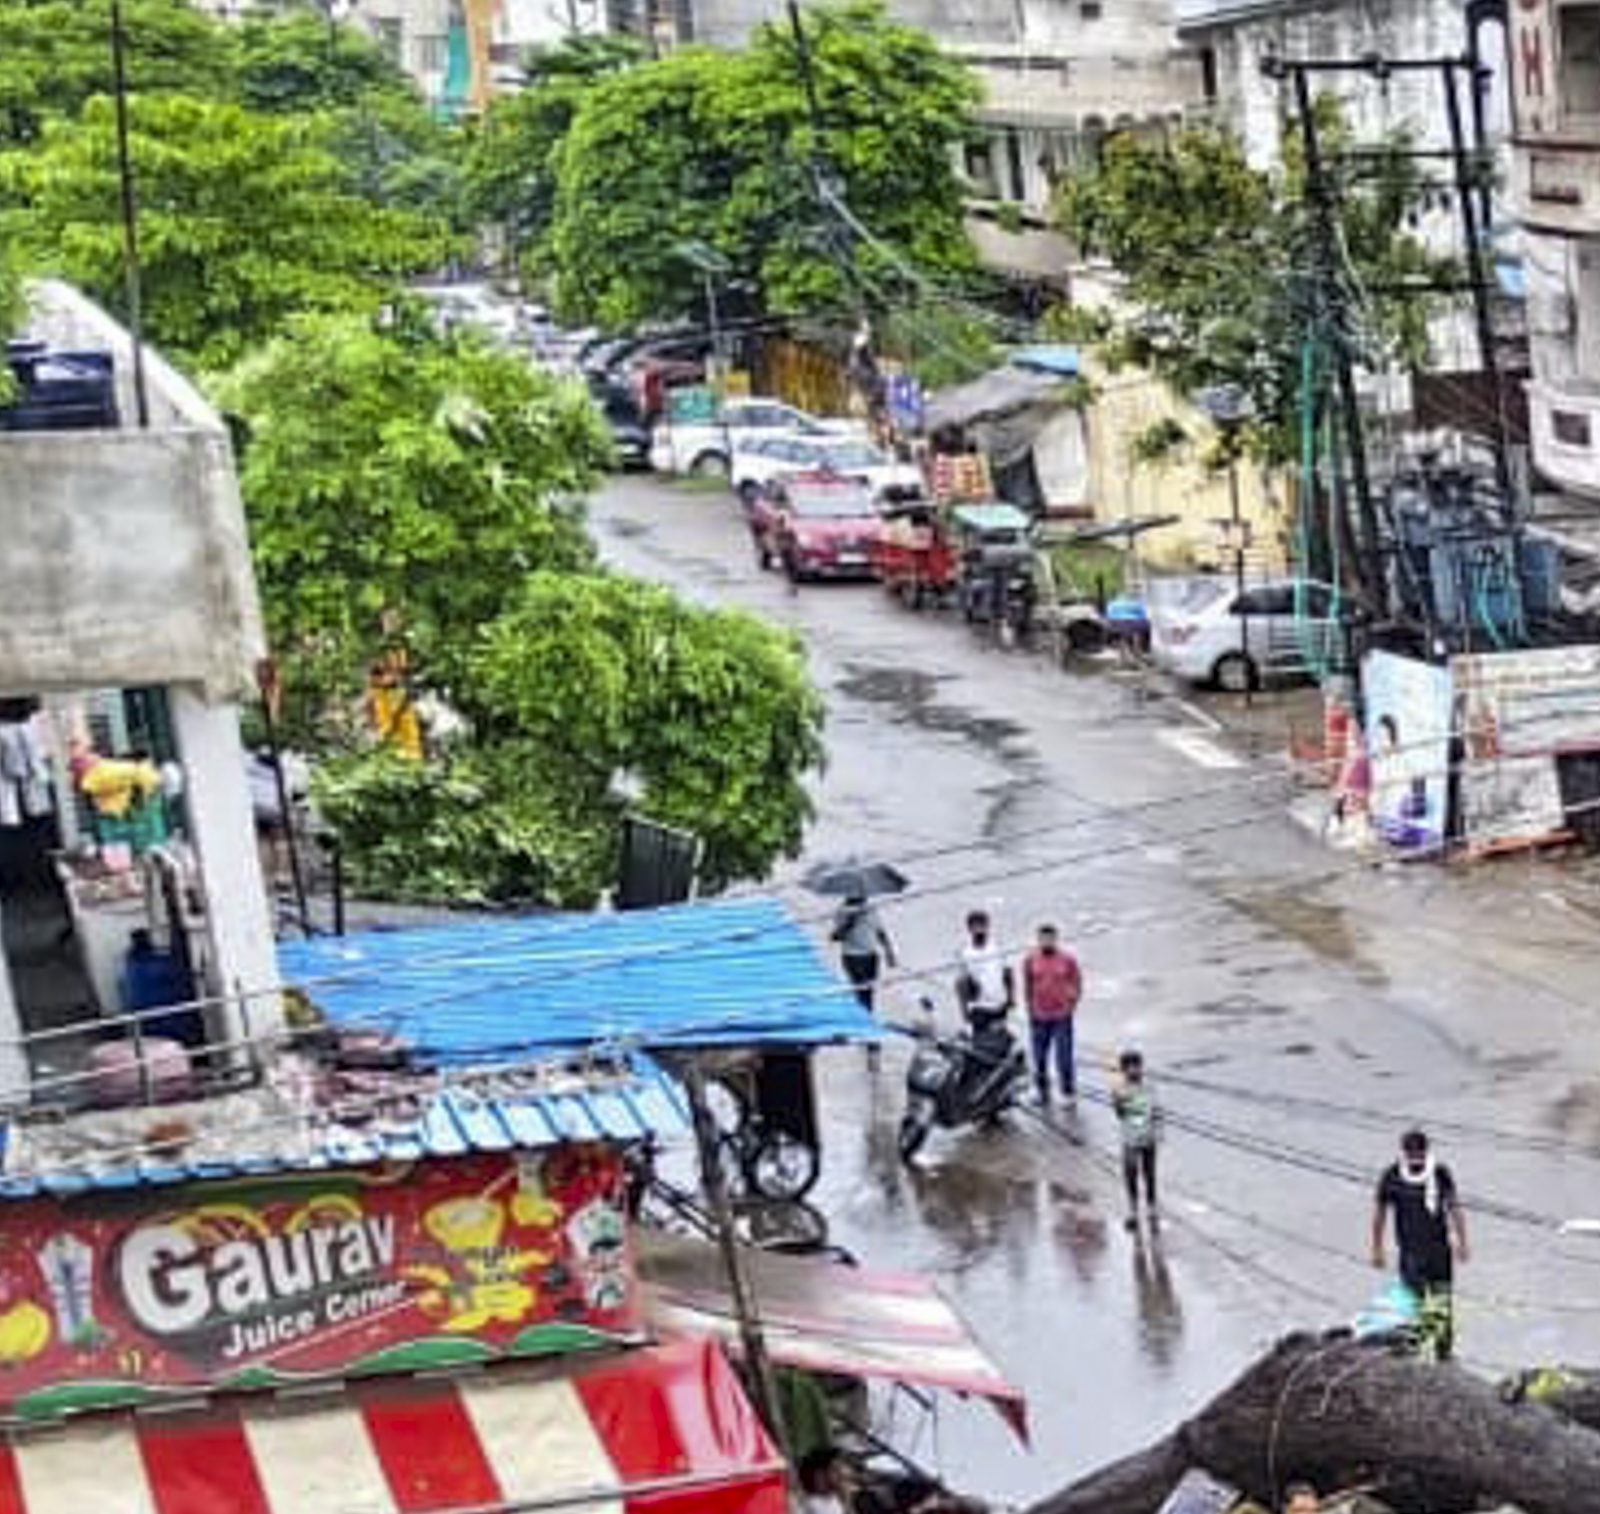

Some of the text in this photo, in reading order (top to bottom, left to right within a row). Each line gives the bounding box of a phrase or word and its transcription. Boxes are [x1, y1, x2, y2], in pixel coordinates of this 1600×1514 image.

[120, 1213, 395, 1333] Gaurav
[221, 1279, 407, 1358] Juice Corner
